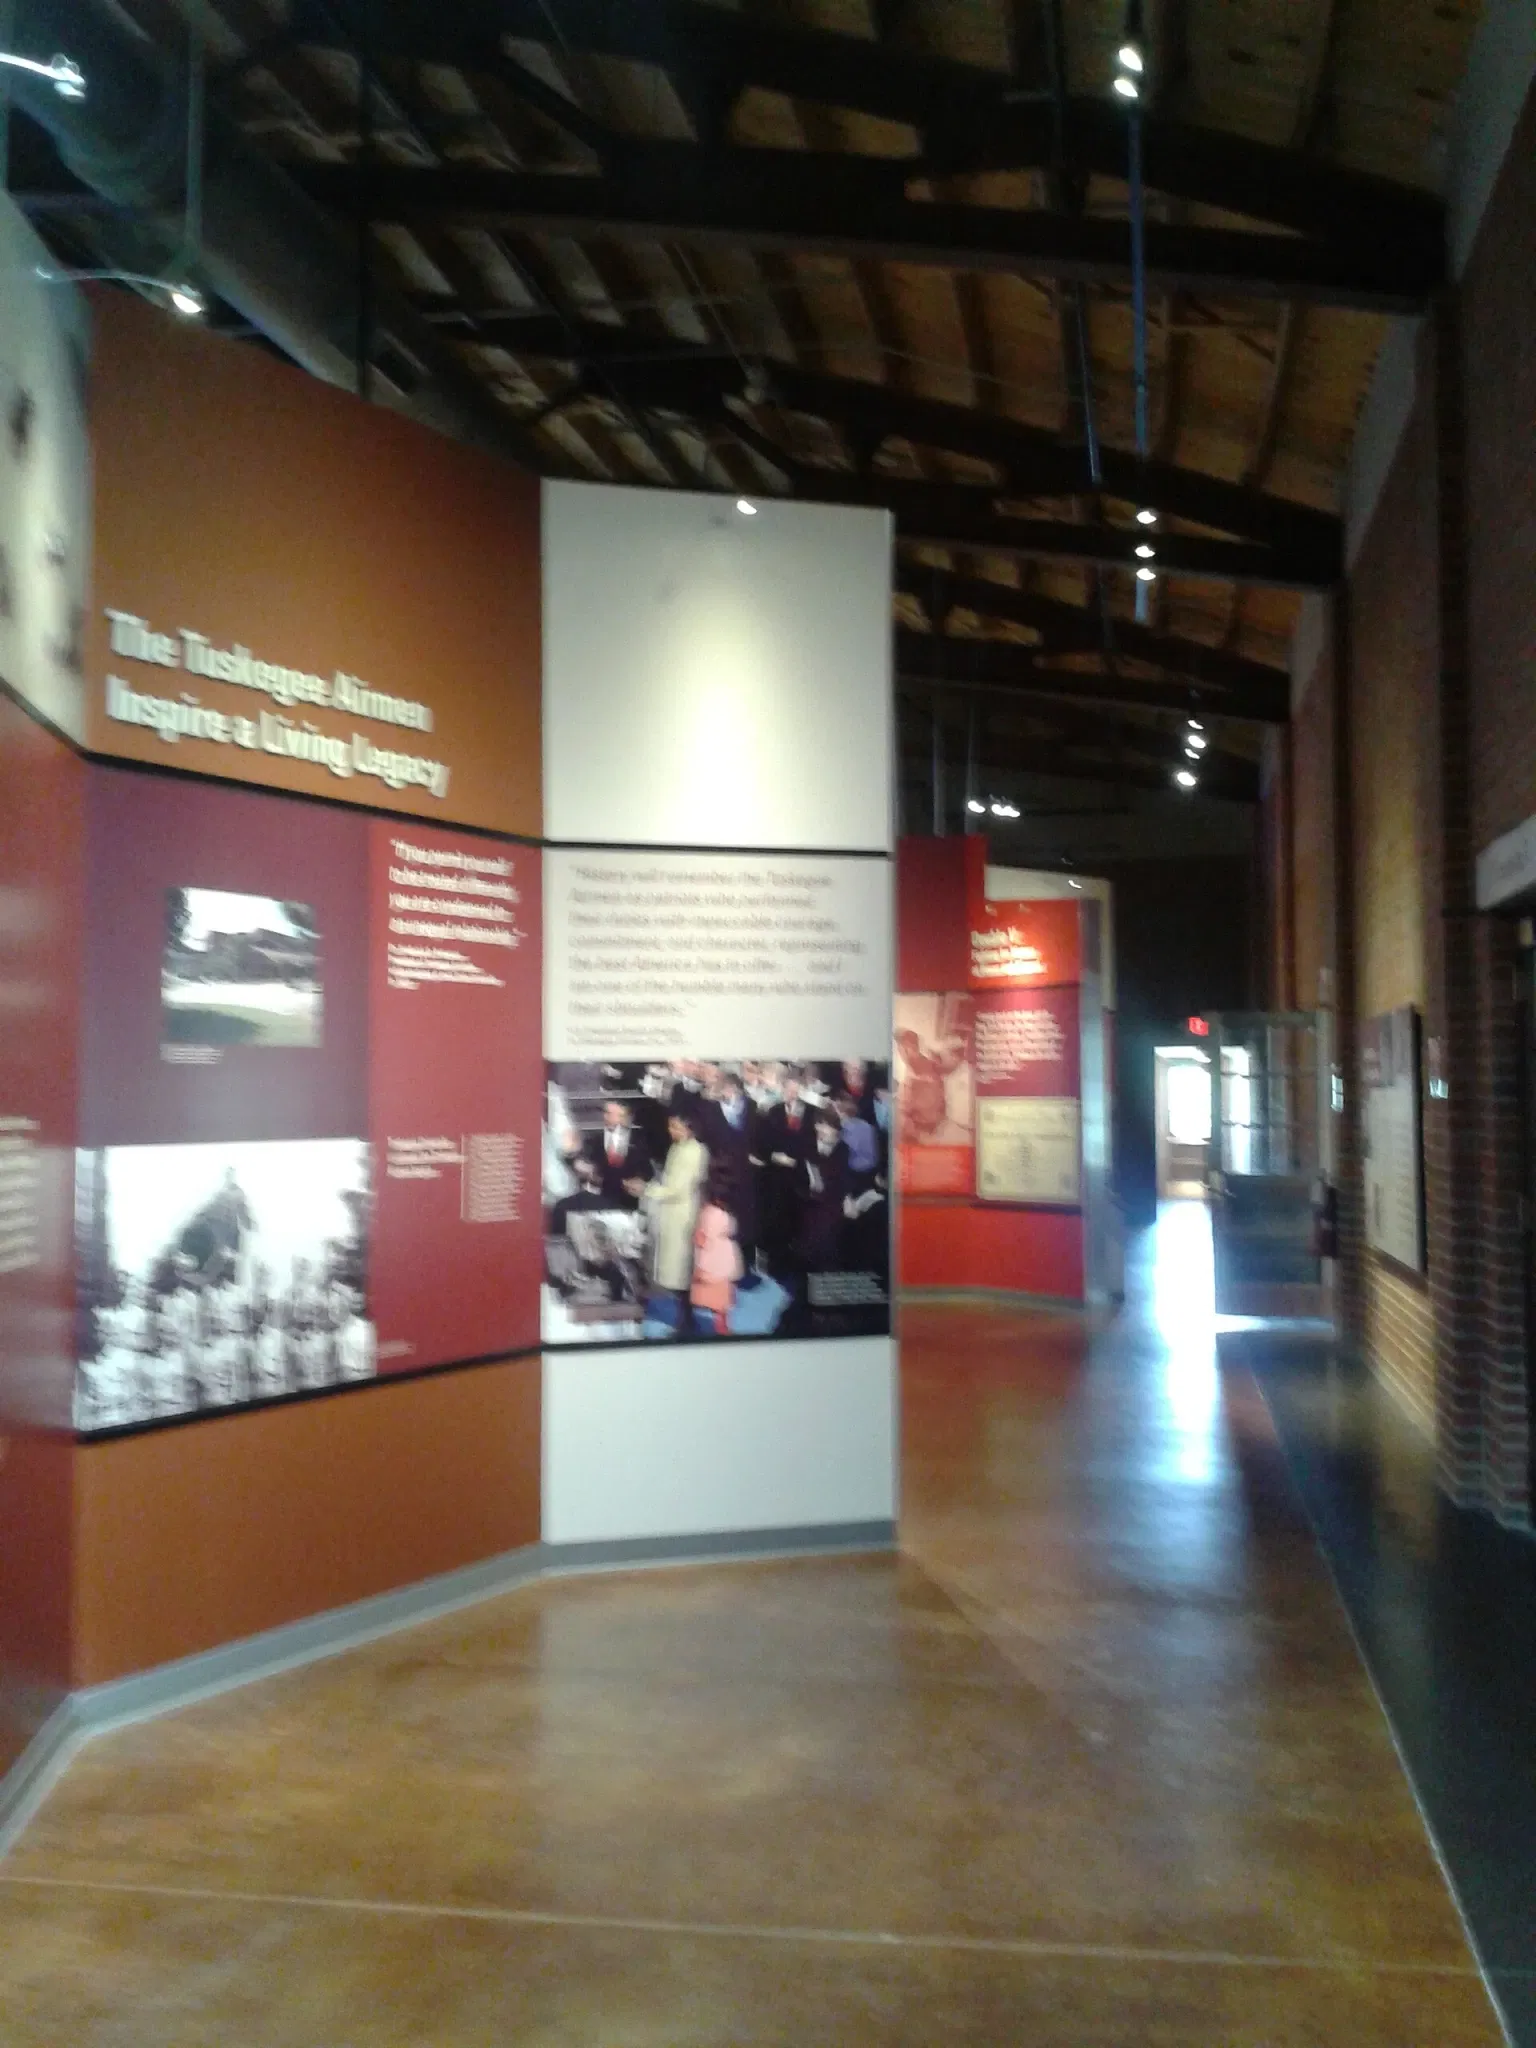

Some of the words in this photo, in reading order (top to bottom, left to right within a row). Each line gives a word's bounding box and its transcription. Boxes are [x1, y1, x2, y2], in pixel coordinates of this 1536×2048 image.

[104, 608, 179, 667] The
[178, 628, 331, 706] Tuskegee
[331, 670, 433, 733] Airmen
[105, 673, 230, 743] Inspire
[230, 713, 259, 749] a
[259, 709, 353, 778] Living
[352, 732, 453, 799] Legacy
